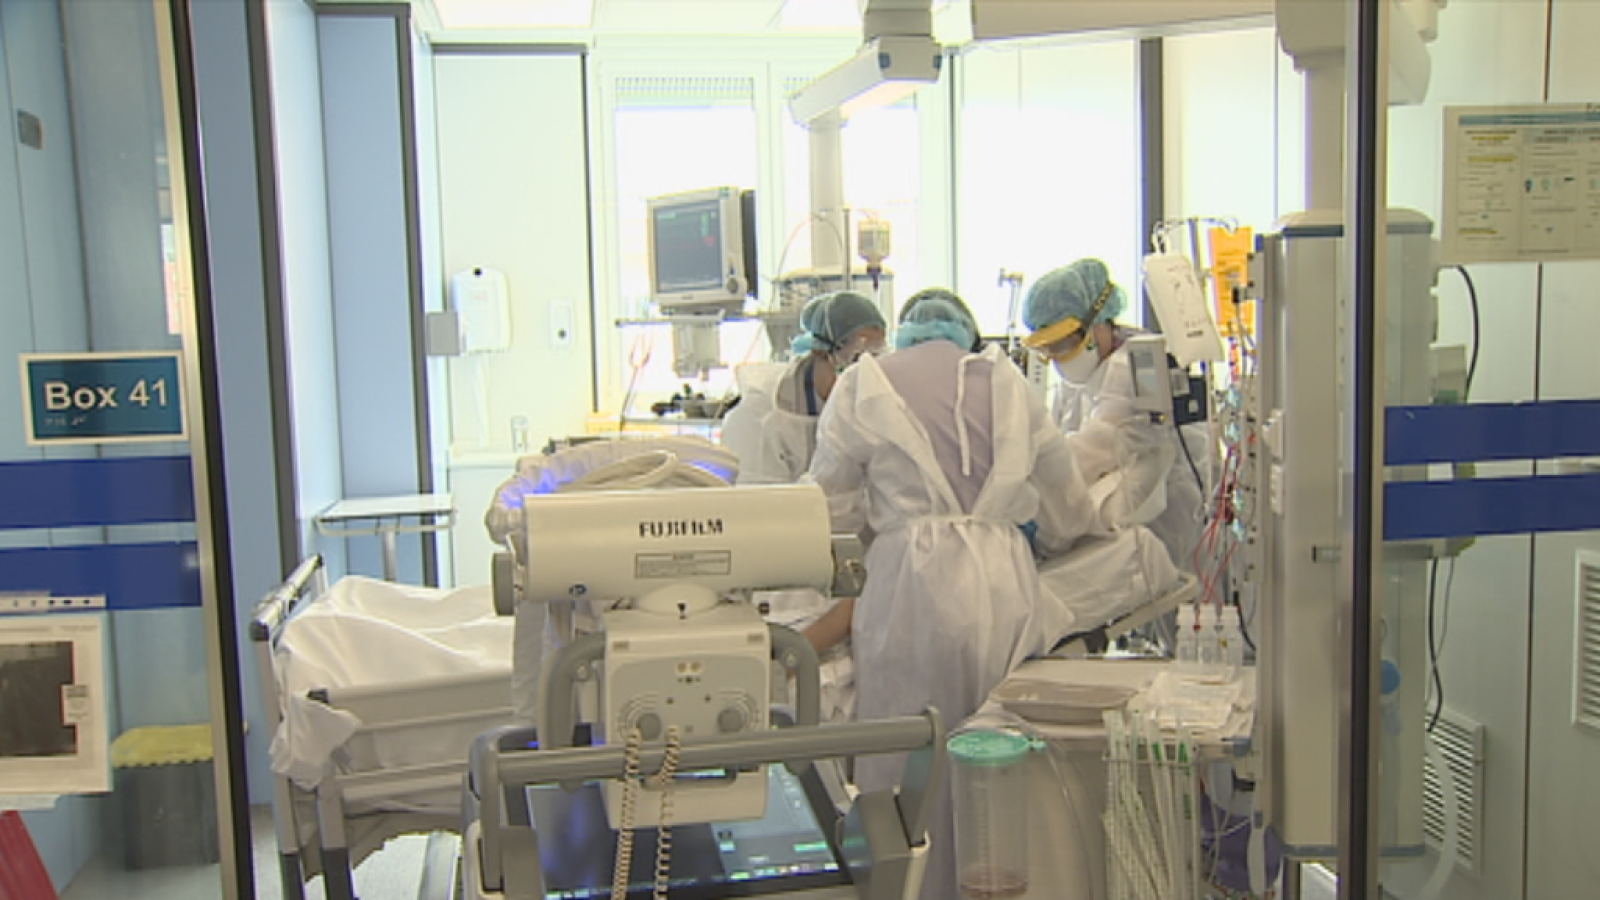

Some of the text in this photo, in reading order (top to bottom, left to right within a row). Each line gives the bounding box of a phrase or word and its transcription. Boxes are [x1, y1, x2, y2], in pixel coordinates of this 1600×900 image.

[45, 379, 167, 409] Box 41
[639, 518, 723, 537] FUJIFILM
